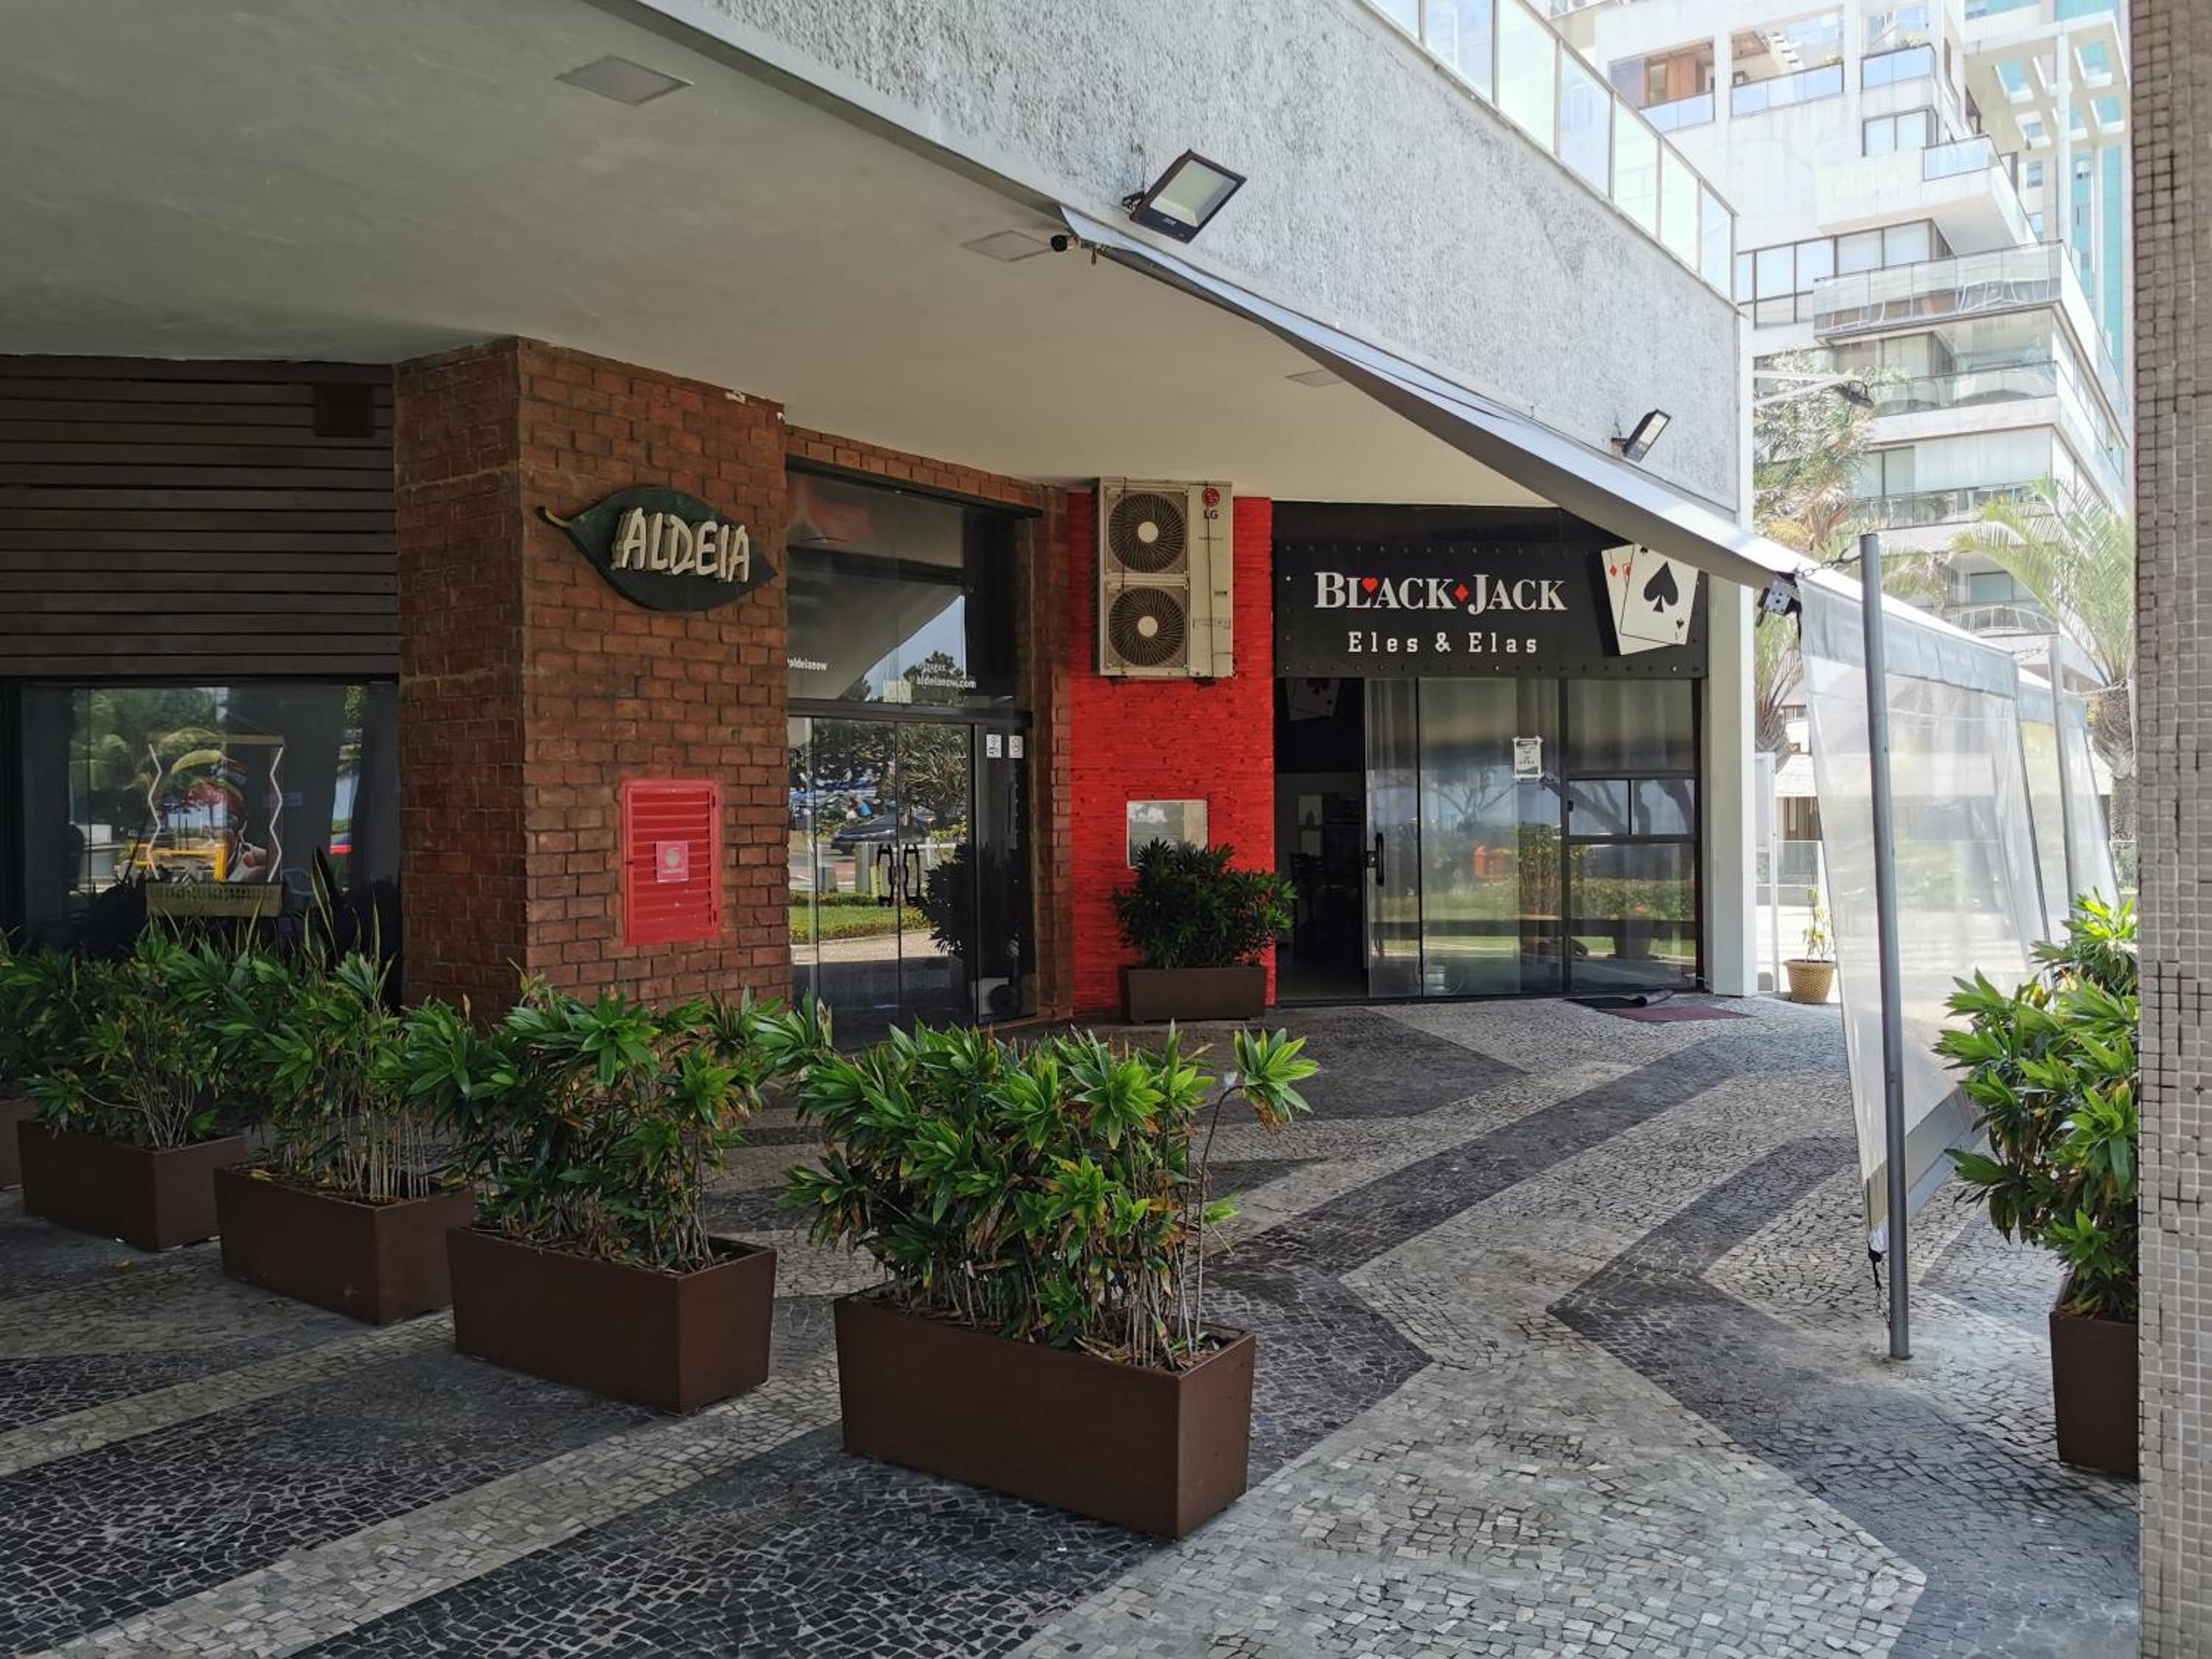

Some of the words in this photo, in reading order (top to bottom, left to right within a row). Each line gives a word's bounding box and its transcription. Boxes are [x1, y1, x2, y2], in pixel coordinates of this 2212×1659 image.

[1203, 509, 1219, 520] LG
[621, 507, 751, 583] ALDEIA
[1314, 571, 1457, 610] BLACK
[1467, 574, 1568, 615] JACK
[1348, 631, 1419, 653] Eles
[1434, 632, 1452, 653] &
[1468, 632, 1537, 653] Elas
